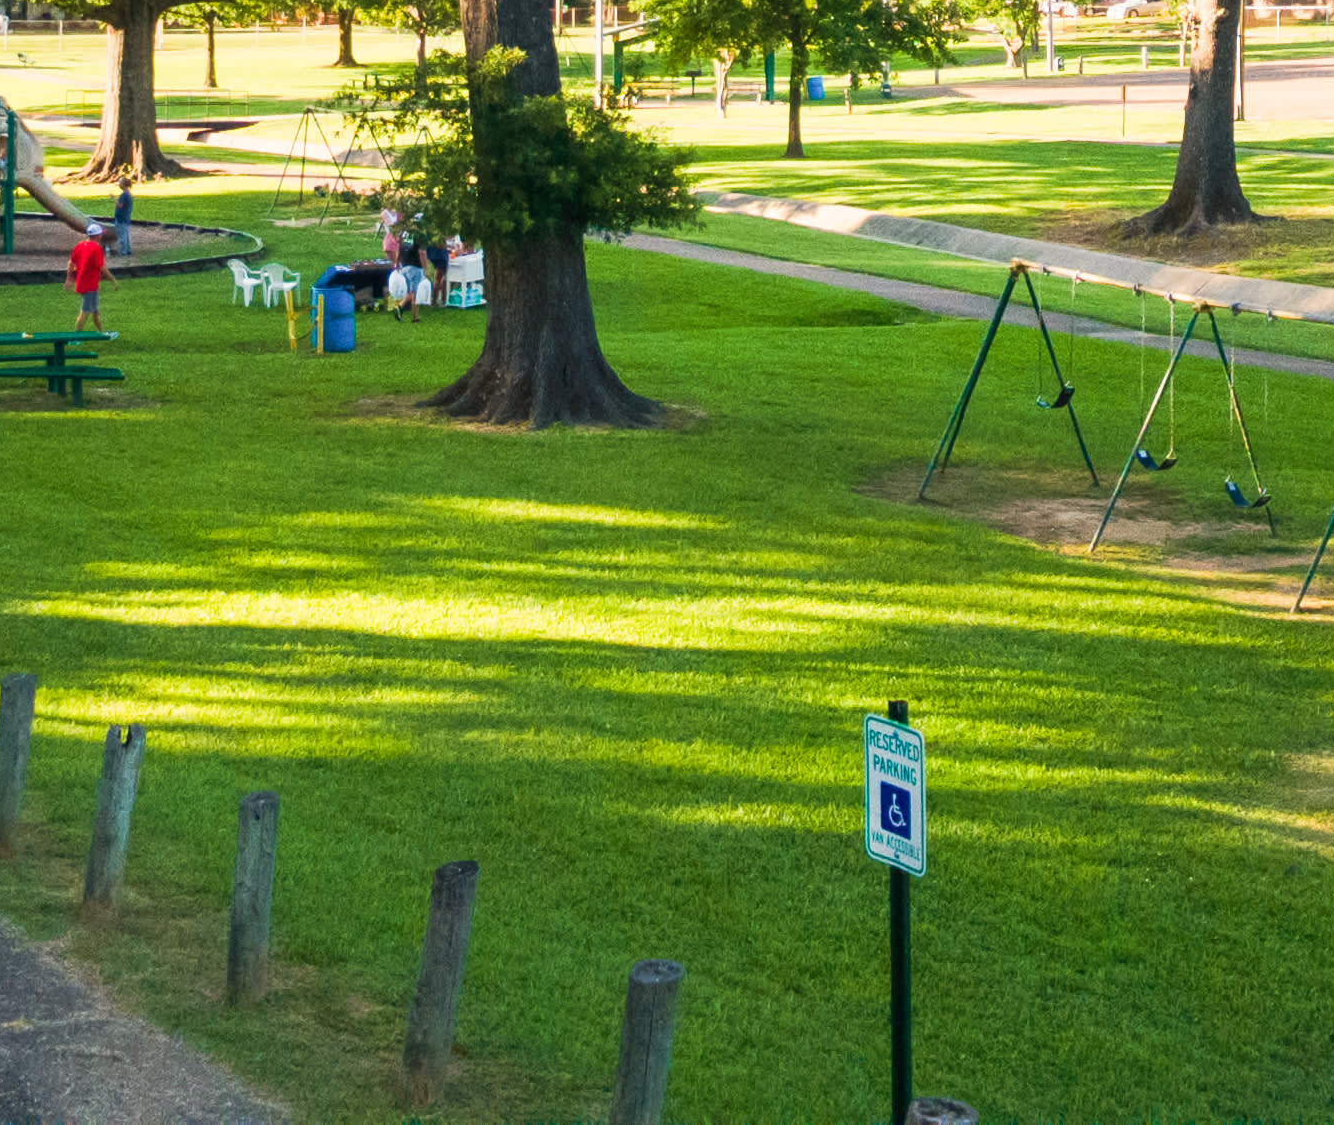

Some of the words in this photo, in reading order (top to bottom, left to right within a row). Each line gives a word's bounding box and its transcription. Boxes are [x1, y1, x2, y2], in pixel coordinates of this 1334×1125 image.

[869, 729, 920, 762] RESERVED
[873, 753, 917, 786] PARKING
[871, 831, 884, 844] VAN
